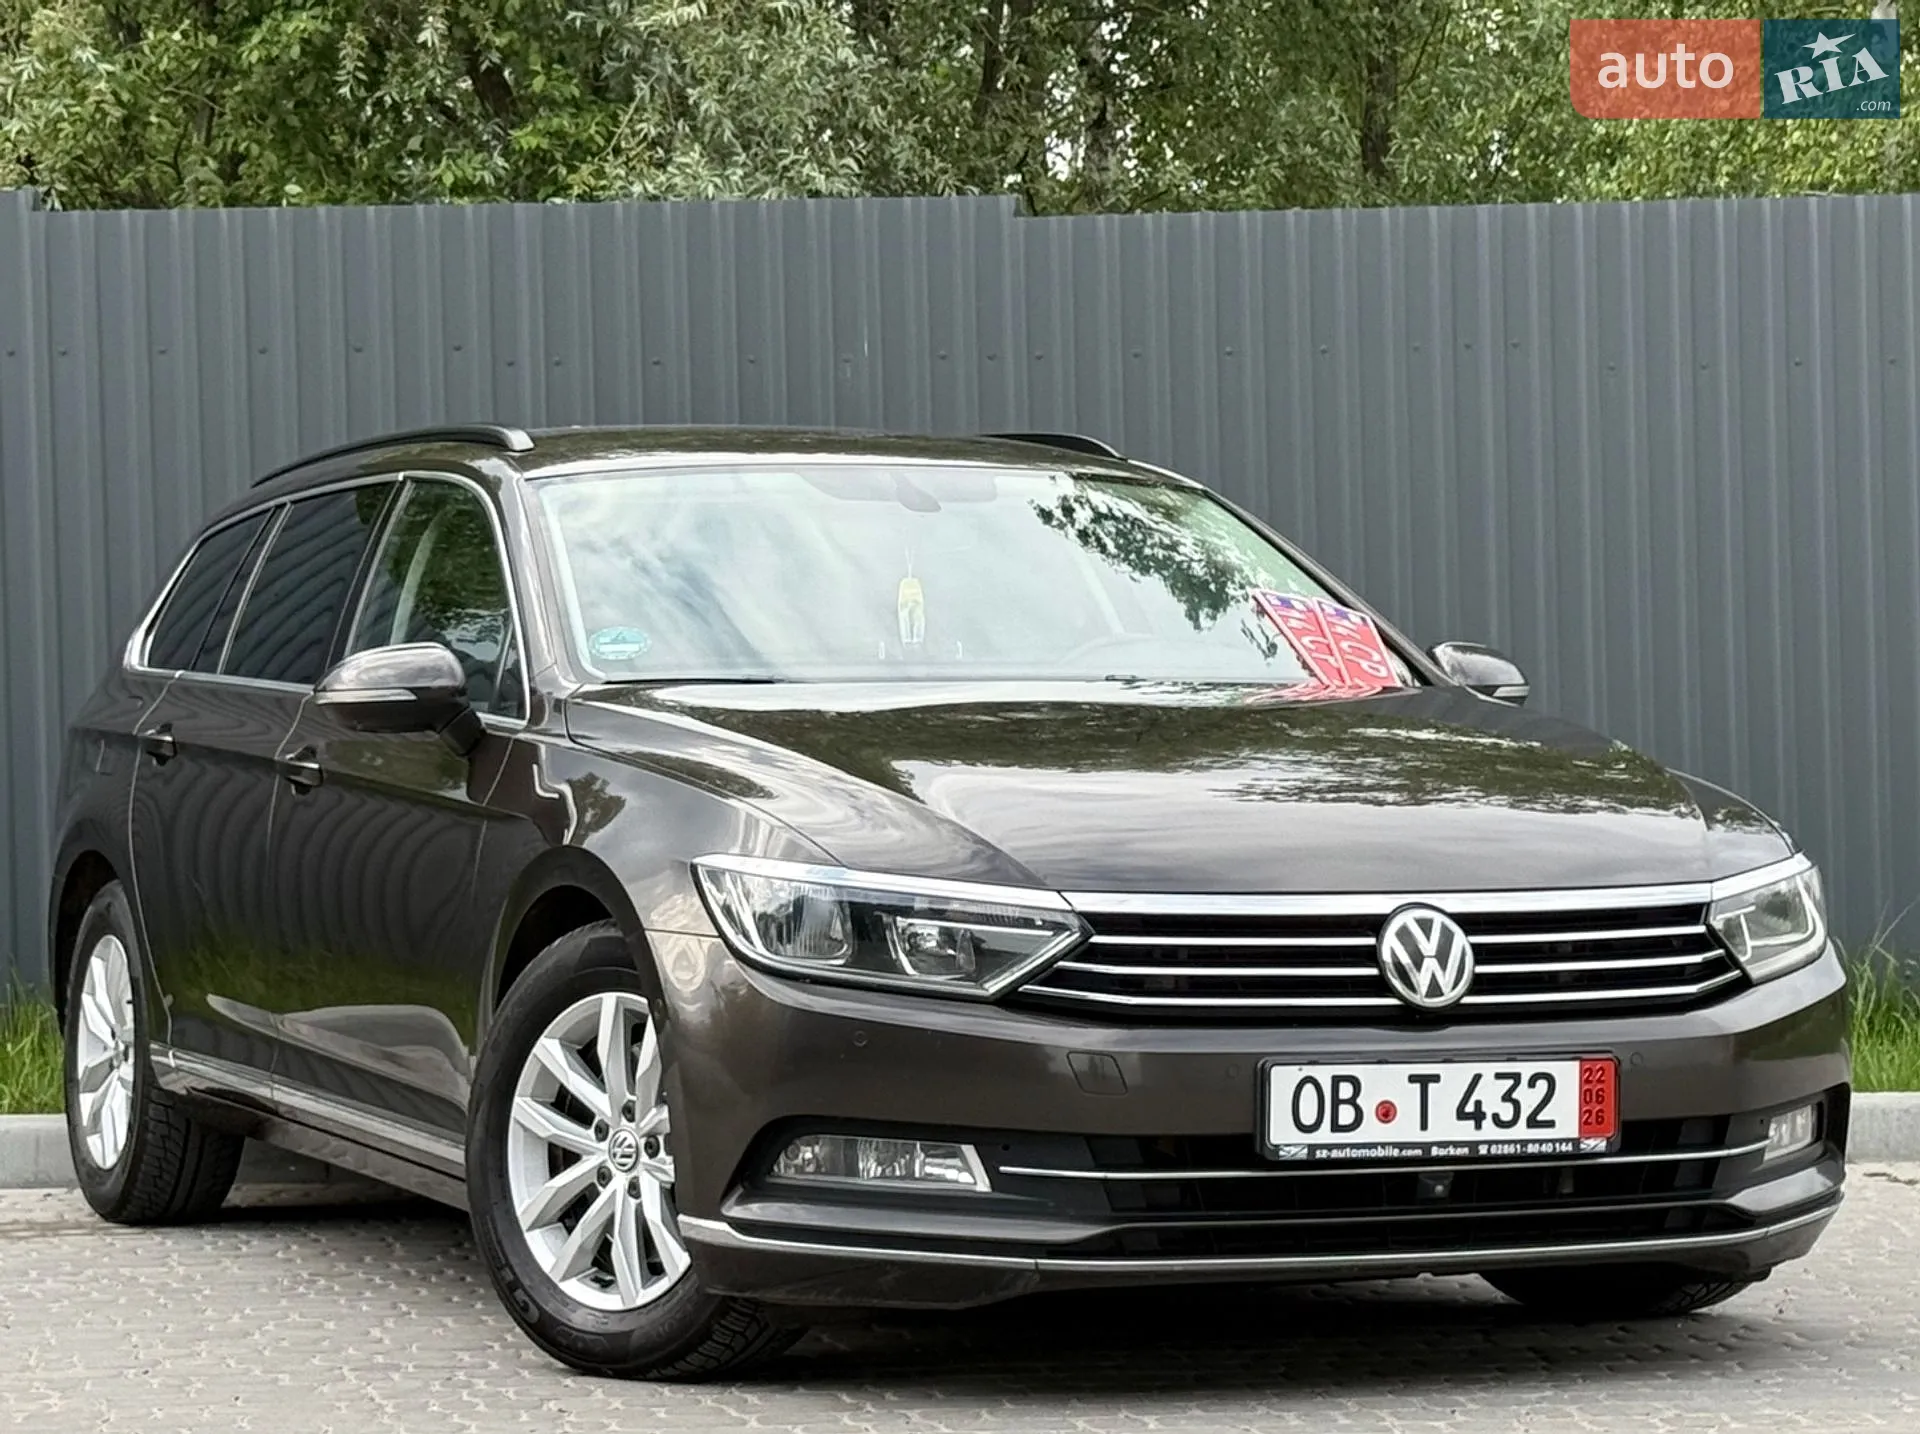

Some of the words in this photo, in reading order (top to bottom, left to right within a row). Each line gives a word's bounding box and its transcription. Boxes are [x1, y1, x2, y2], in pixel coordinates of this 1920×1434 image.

[1583, 1067, 1605, 1084] 22
[1292, 1075, 1364, 1134] OB
[1408, 1074, 1441, 1131] T
[1456, 1072, 1556, 1130] 432
[1583, 1088, 1605, 1104] 06
[1583, 1108, 1605, 1126] 26
